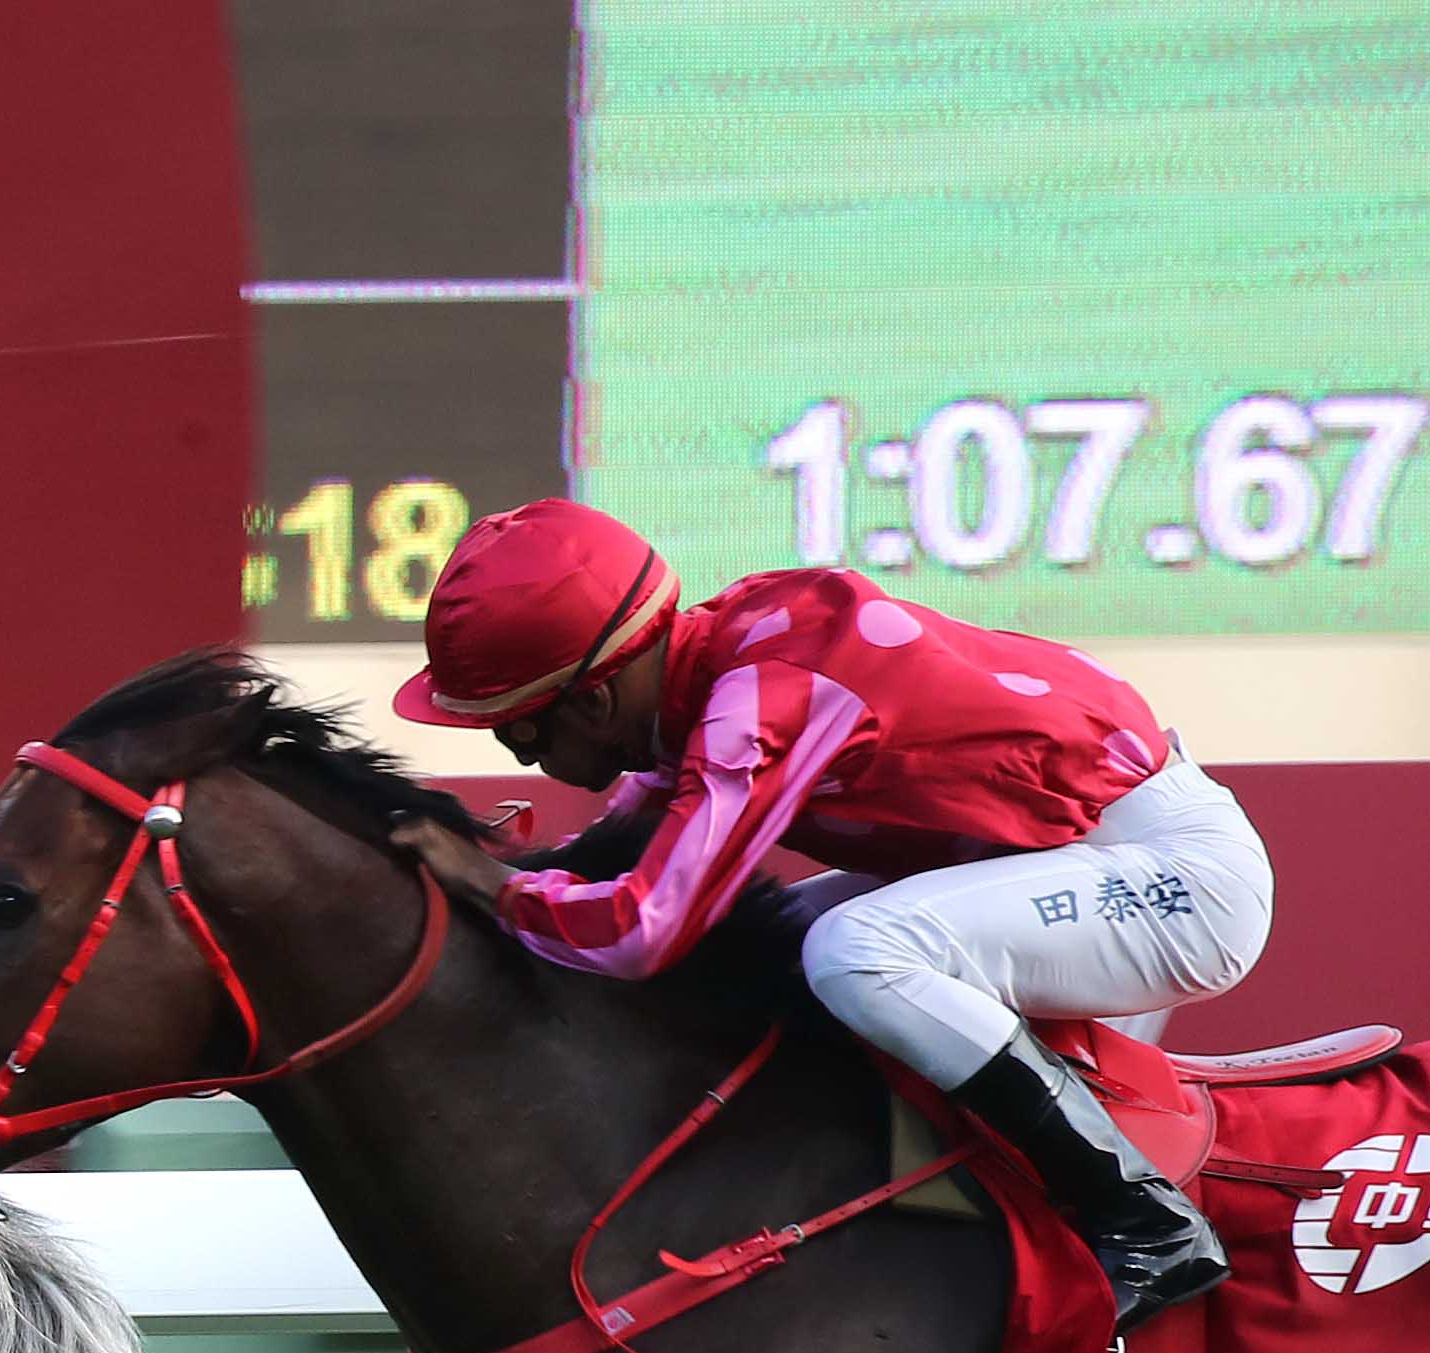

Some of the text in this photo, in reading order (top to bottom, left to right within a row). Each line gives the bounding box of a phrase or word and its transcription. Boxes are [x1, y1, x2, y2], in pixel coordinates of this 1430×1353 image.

[762, 394, 1428, 568] 1:07.67
[1028, 872, 1193, 927] 田泰安
[1352, 1181, 1430, 1230] 中
